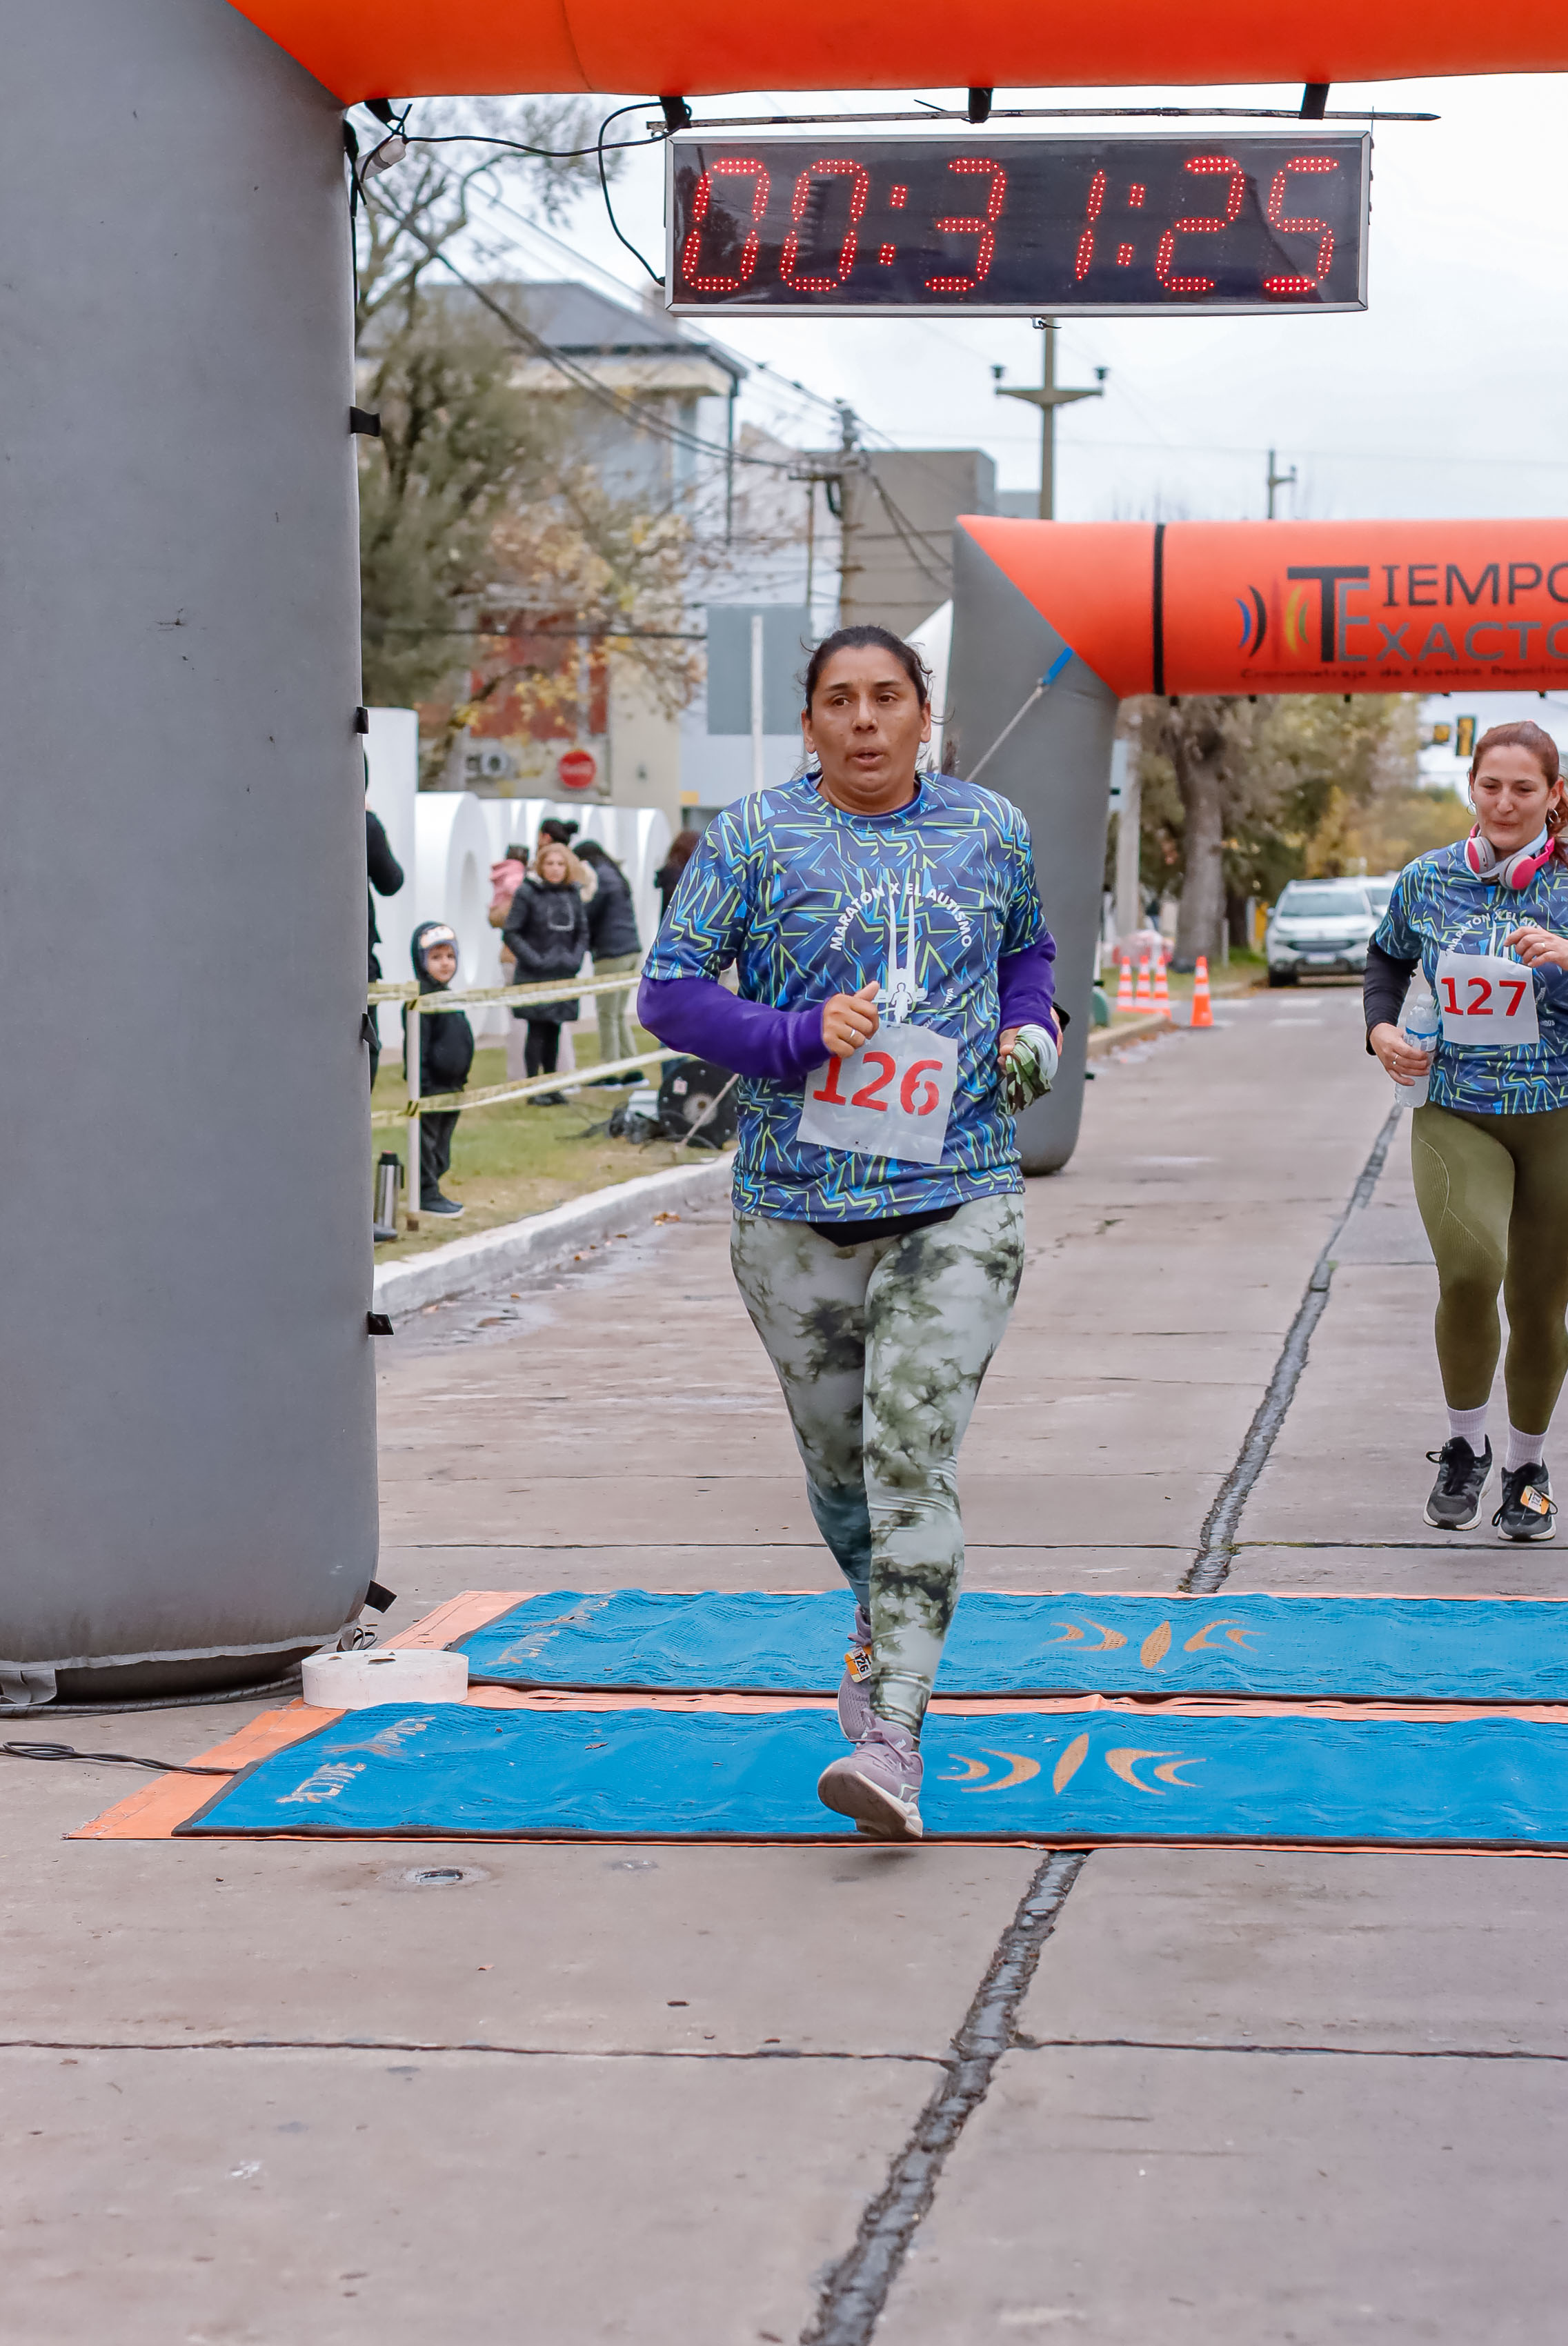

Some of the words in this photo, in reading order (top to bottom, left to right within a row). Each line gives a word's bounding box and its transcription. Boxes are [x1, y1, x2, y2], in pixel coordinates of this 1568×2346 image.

[682, 157, 1340, 292] 00:31:25
[830, 886, 885, 951] MARATÓN
[890, 883, 901, 895] X
[906, 883, 922, 896] EL
[925, 888, 972, 948] AUTISMO
[1441, 977, 1527, 1017] 127
[813, 1051, 944, 1115] 126
